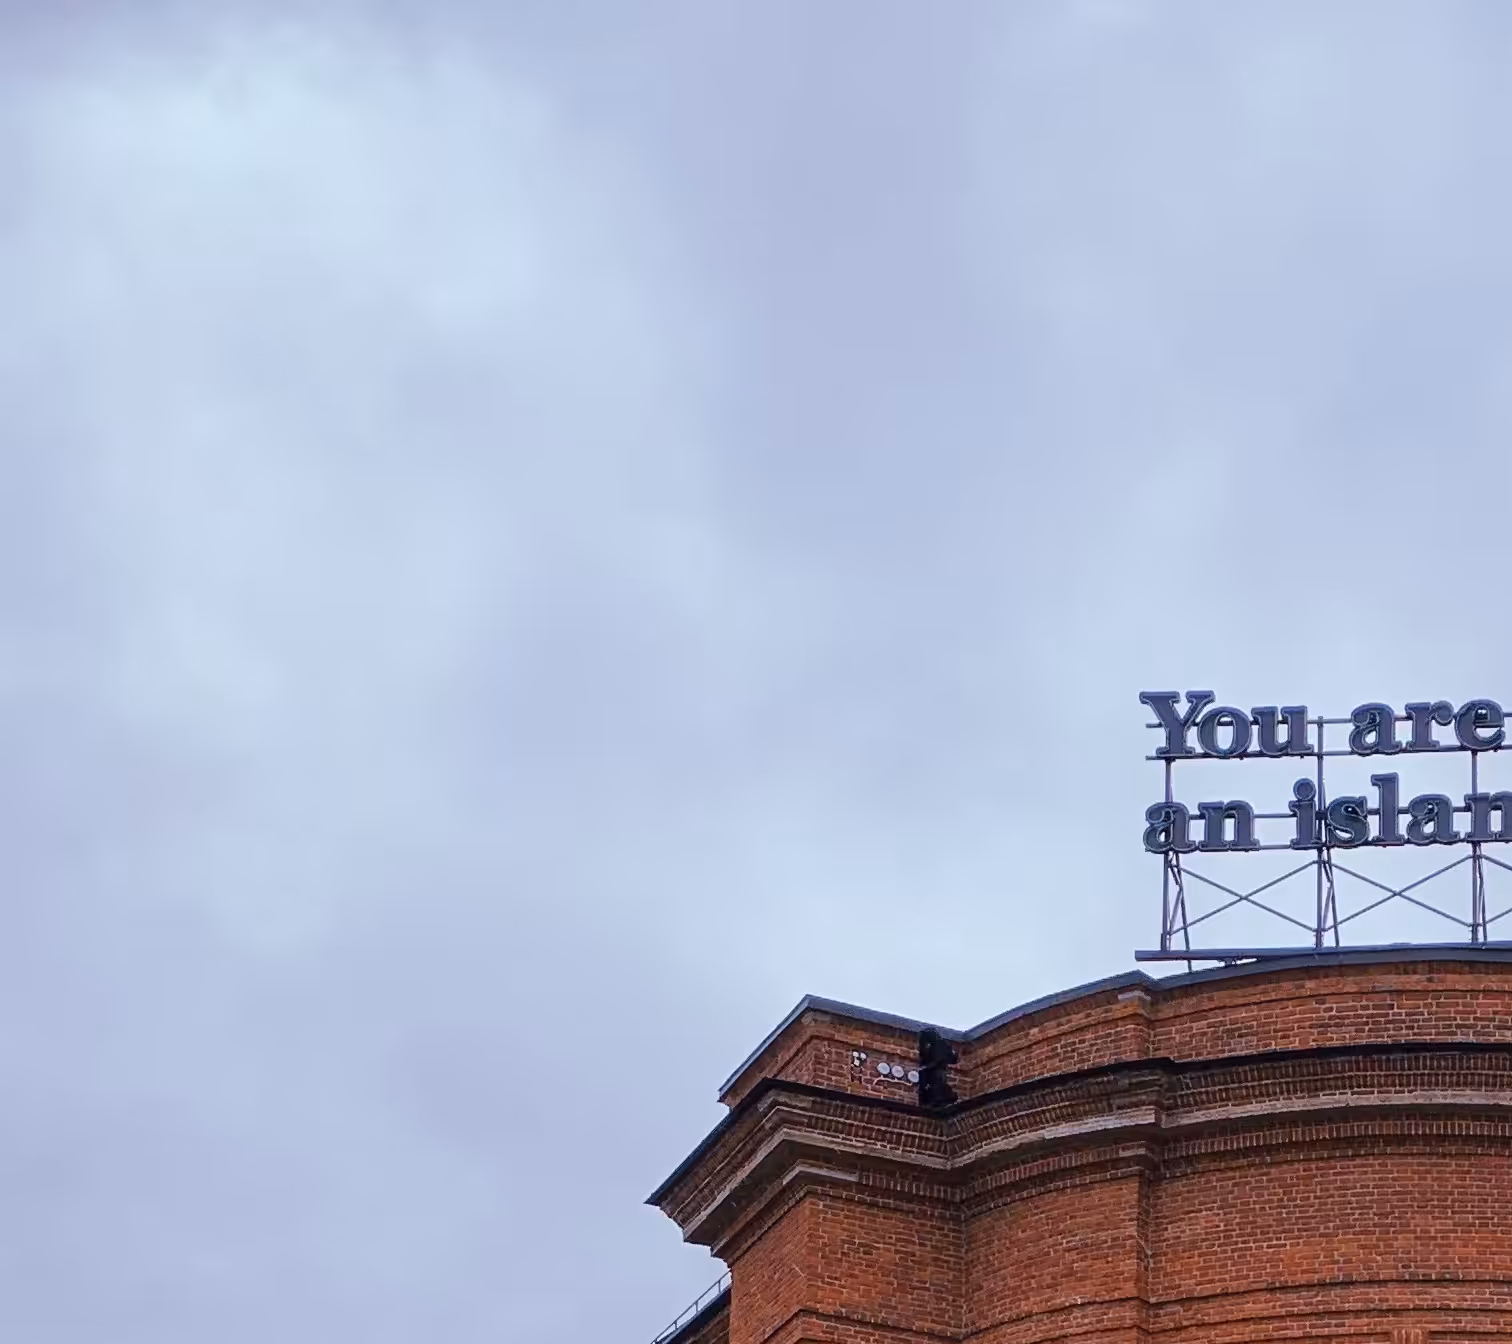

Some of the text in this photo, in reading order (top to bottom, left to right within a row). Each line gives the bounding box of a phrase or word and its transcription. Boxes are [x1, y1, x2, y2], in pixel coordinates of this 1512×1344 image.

[1139, 690, 1312, 758] You
[1348, 699, 1505, 755] are
[1143, 799, 1260, 854] an
